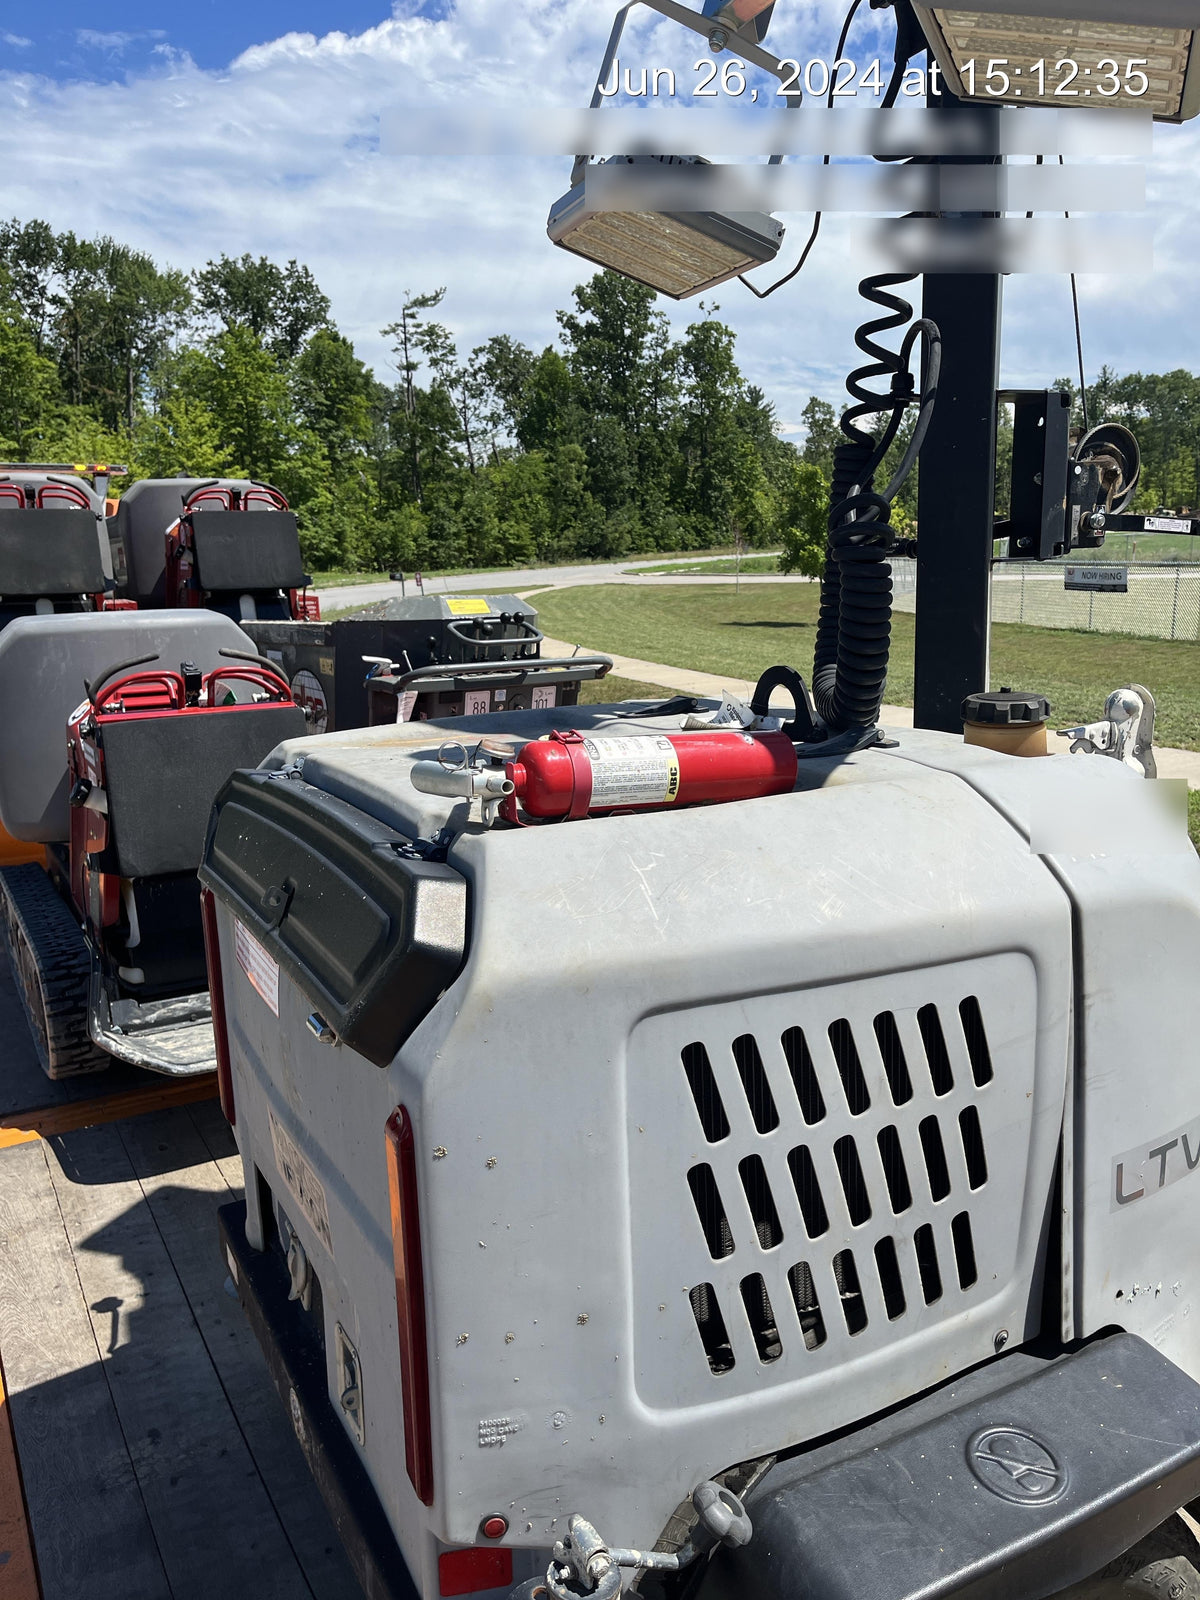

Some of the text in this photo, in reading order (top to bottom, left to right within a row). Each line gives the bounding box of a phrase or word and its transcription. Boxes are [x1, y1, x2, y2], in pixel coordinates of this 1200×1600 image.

[1081, 571, 1122, 580] NOW HIRING
[473, 701, 486, 714] 88
[668, 767, 678, 795] ABC
[1116, 1133, 1200, 1205] LTV
